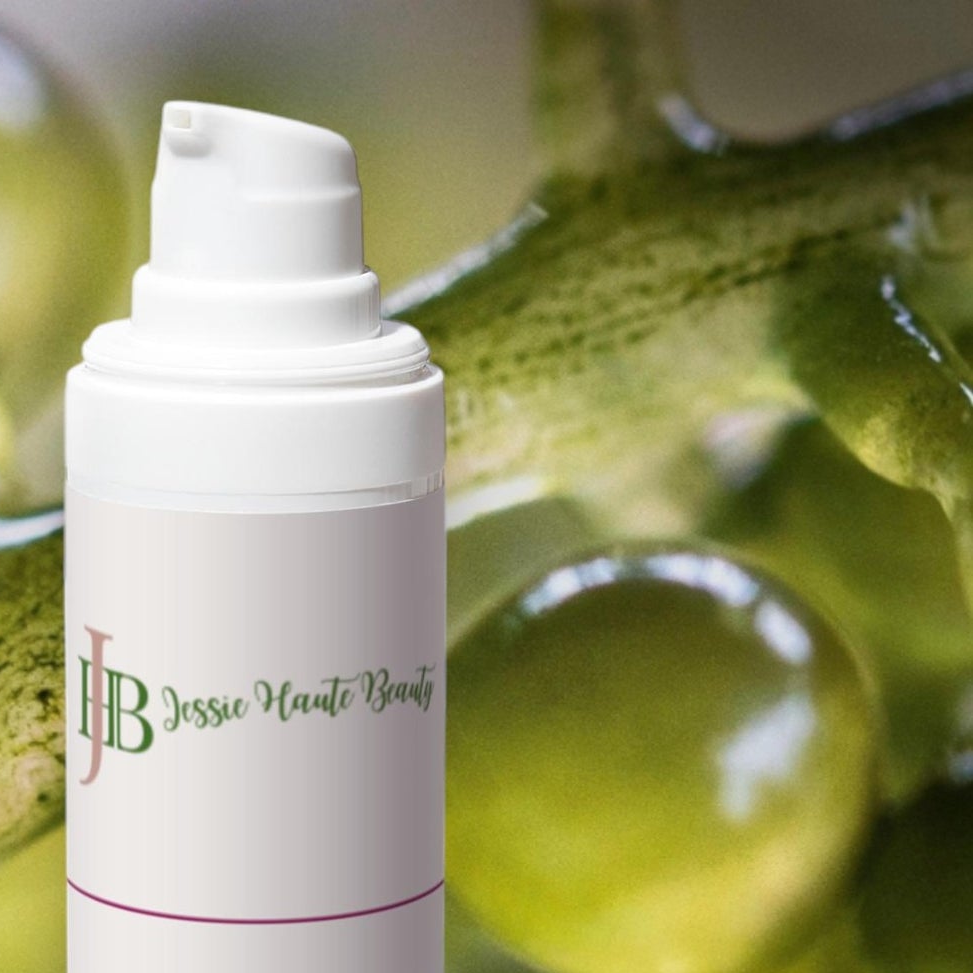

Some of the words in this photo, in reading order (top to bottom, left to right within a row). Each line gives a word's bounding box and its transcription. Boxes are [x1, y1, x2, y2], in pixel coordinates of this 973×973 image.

[161, 686, 248, 732] Jessie
[254, 672, 360, 721] Haute
[360, 662, 436, 713] Beauty
